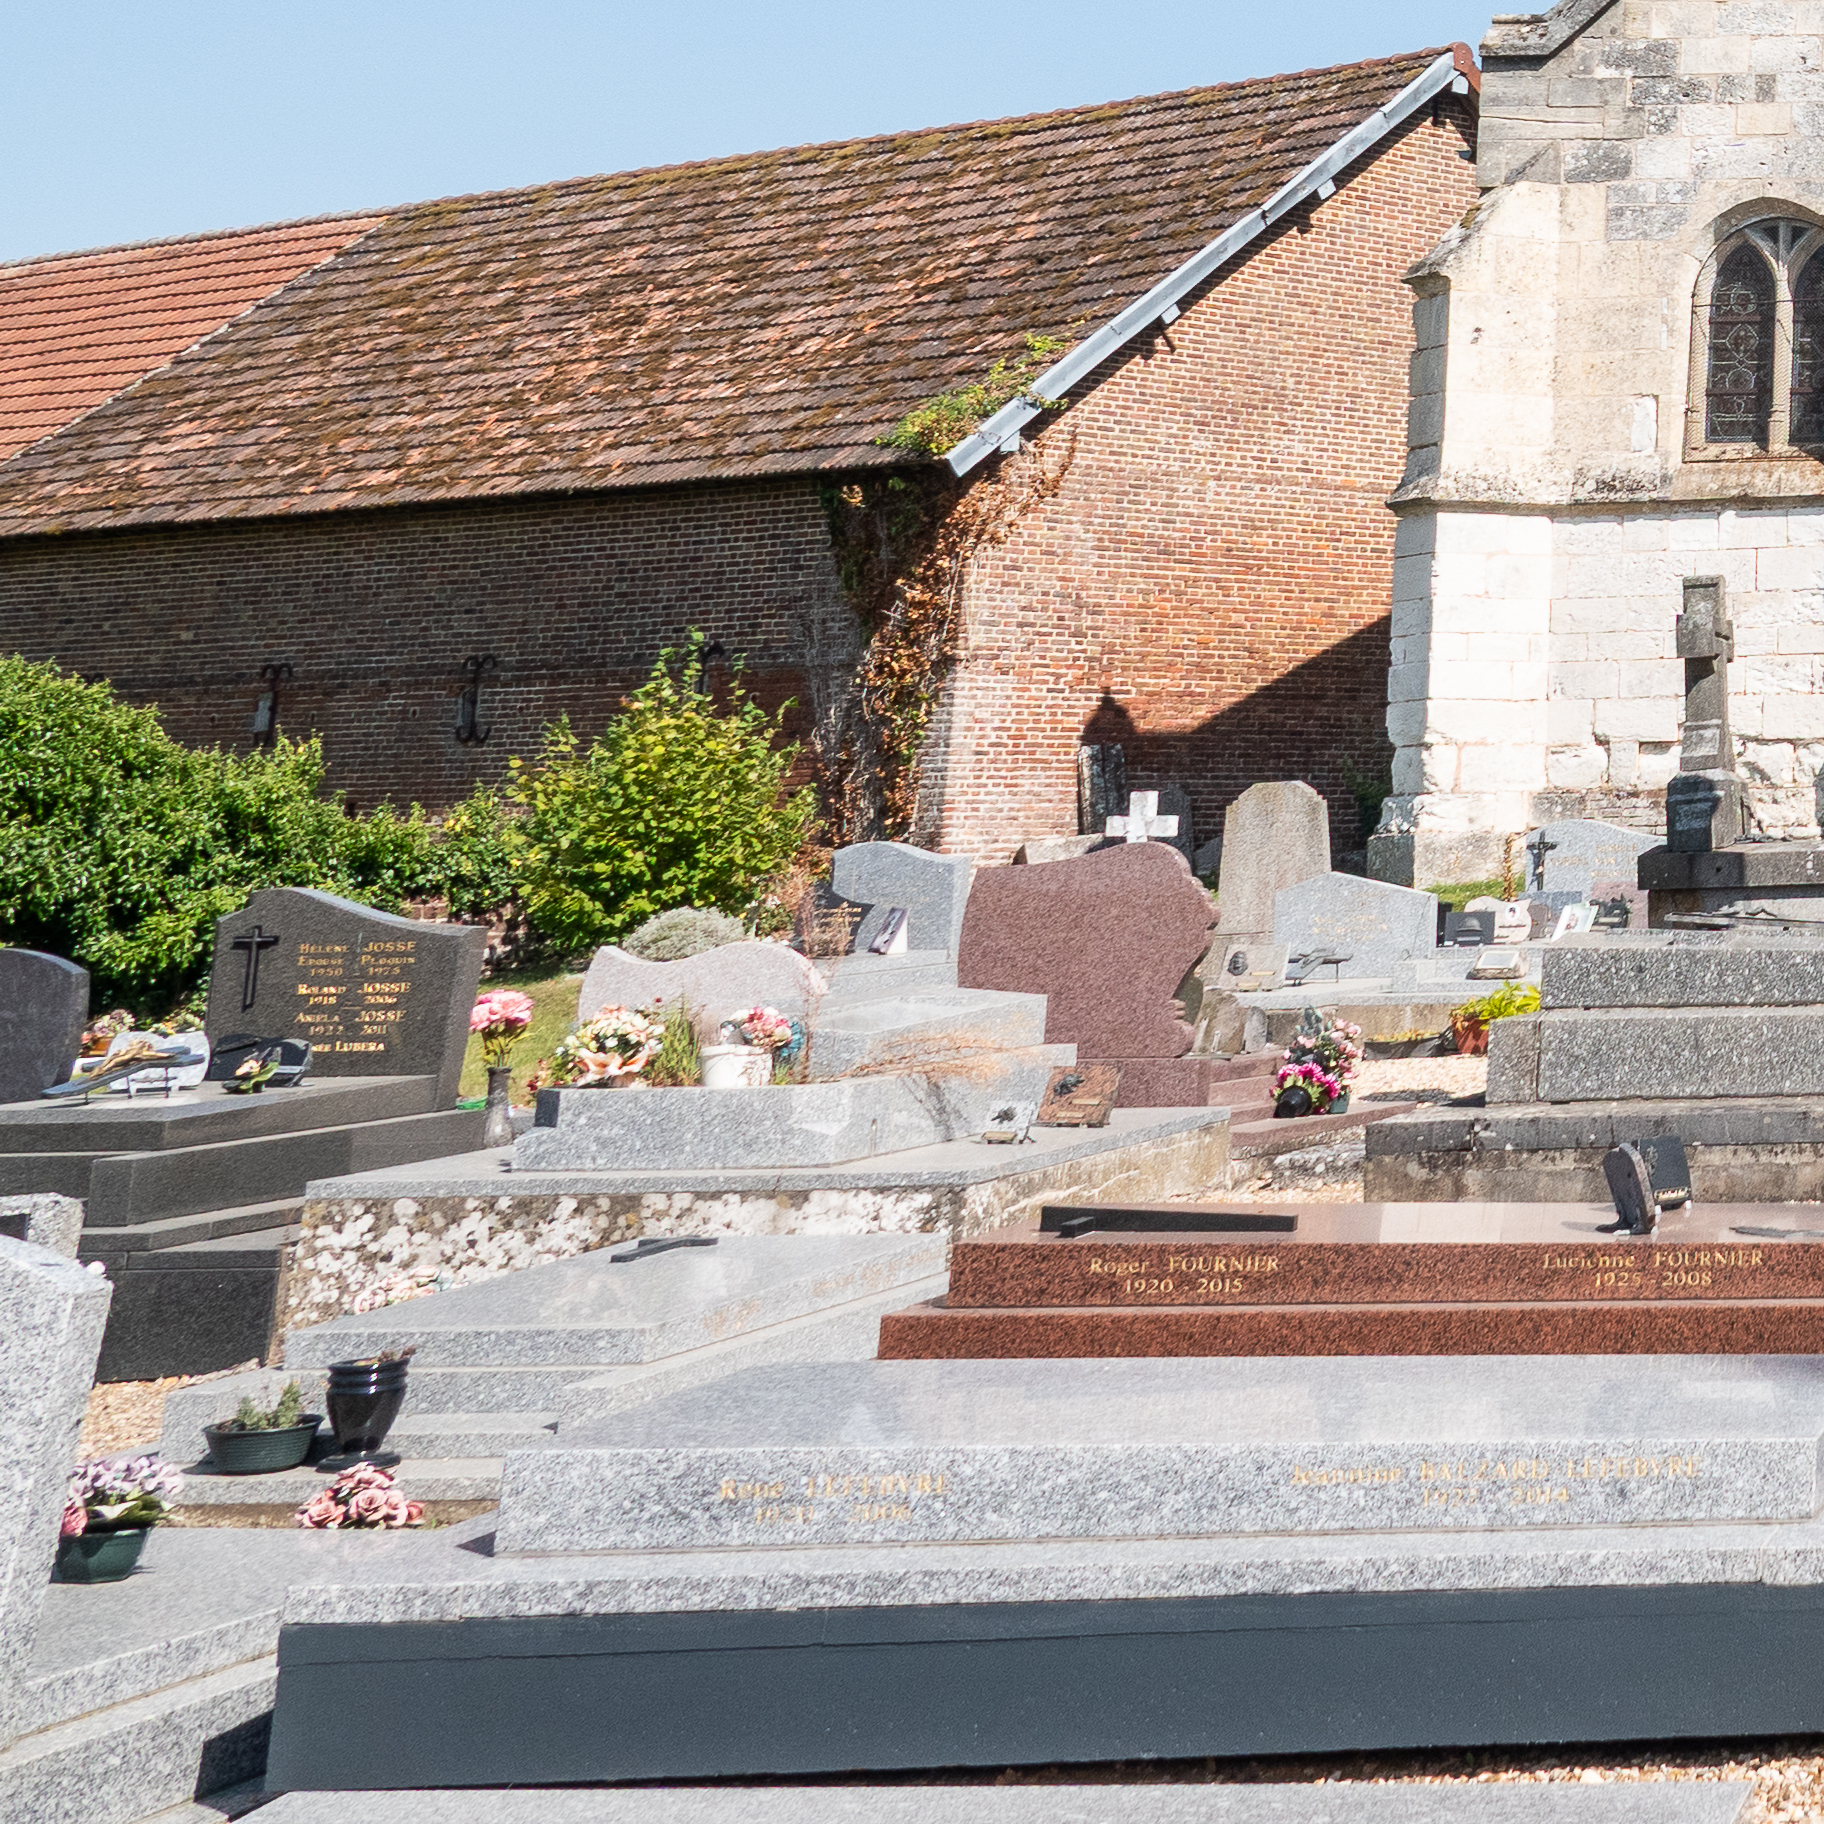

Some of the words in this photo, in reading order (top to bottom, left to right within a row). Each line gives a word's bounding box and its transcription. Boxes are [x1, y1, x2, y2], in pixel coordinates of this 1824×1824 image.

[363, 941, 417, 952] JOSSE
[357, 982, 411, 993] JOSSE
[354, 1010, 407, 1022] JOSSE
[1090, 1257, 1150, 1275] Roger
[1169, 1255, 1279, 1274] FOURNIER
[1542, 1253, 1636, 1269] Lucienne
[1653, 1250, 1764, 1268] FOURNIER
[1124, 1278, 1174, 1294] 1920
[1196, 1277, 1244, 1293] 2015
[1594, 1272, 1643, 1288] 1925
[1661, 1270, 1713, 1287] 2008
[1290, 1464, 1402, 1486] Jeannine
[1566, 1455, 1704, 1478] LEFEBVRE
[806, 1473, 952, 1497] LEFEBVRE
[1510, 1487, 1571, 1504] 2014
